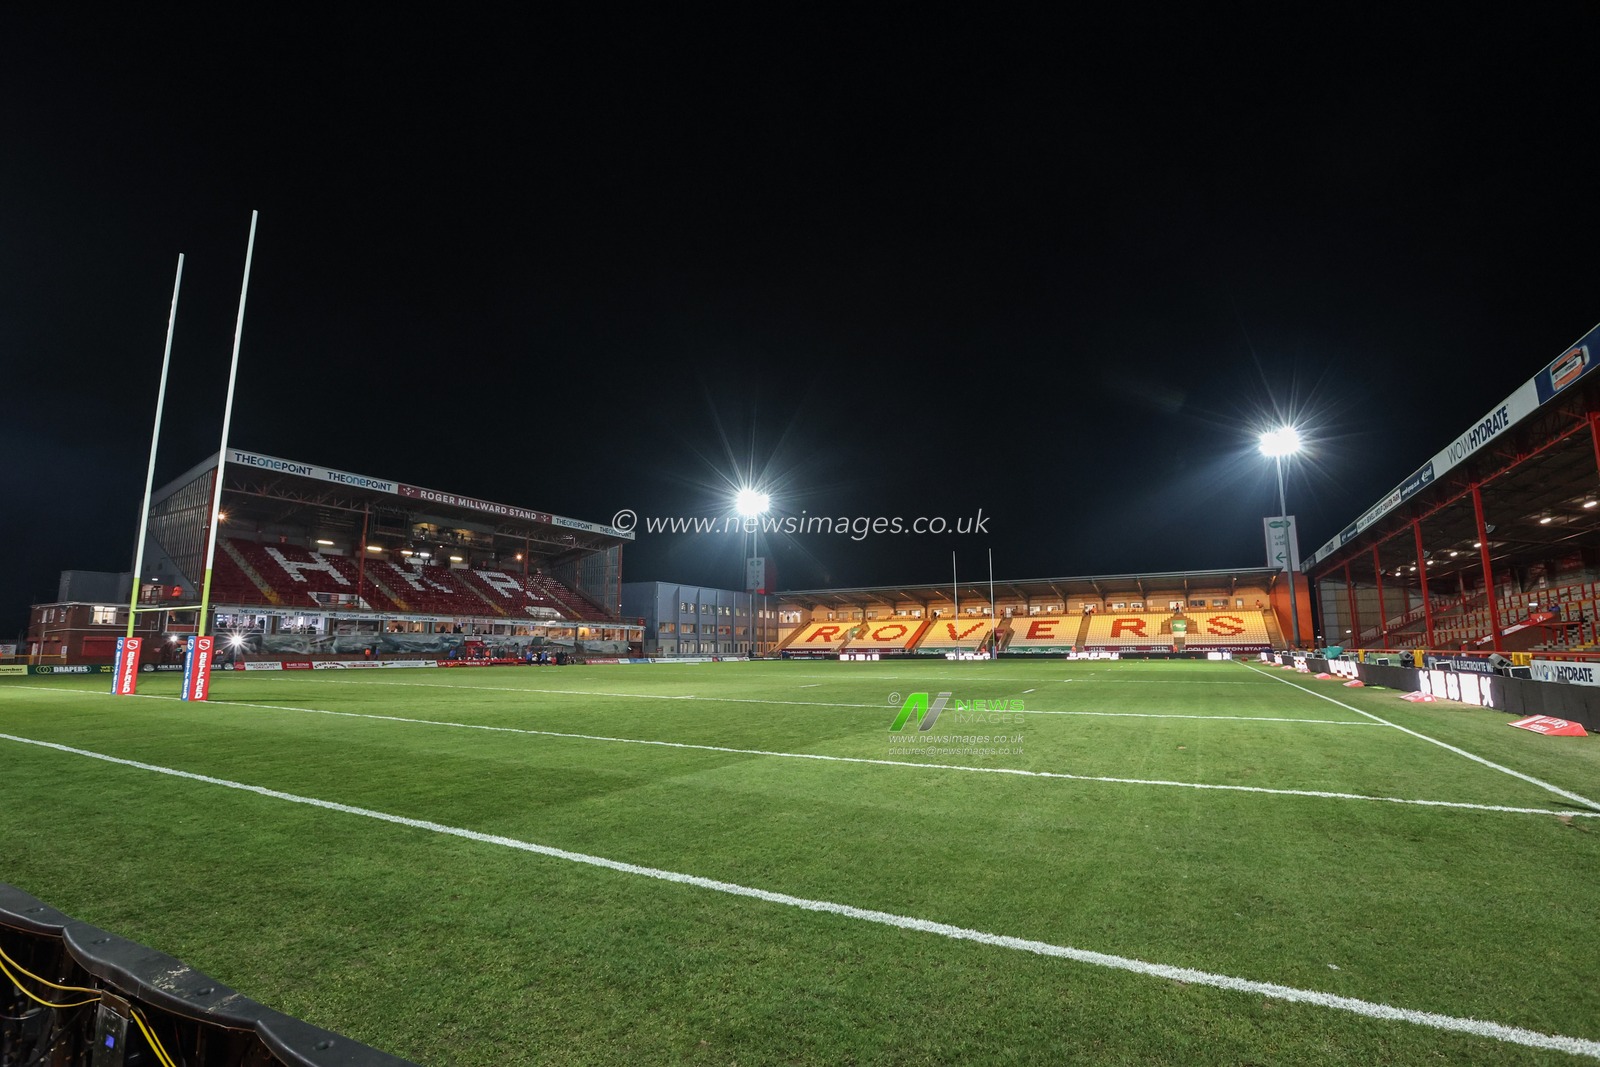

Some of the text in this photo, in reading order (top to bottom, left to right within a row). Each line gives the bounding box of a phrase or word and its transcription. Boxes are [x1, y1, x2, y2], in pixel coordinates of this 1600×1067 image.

[1447, 405, 1509, 464] WOWHYDRATE
[420, 490, 537, 520] ROGER MILLWARD STAND
[53, 665, 88, 673] DRAPERS
[122, 651, 136, 693] BETFRED
[194, 652, 208, 699] BETFRED
